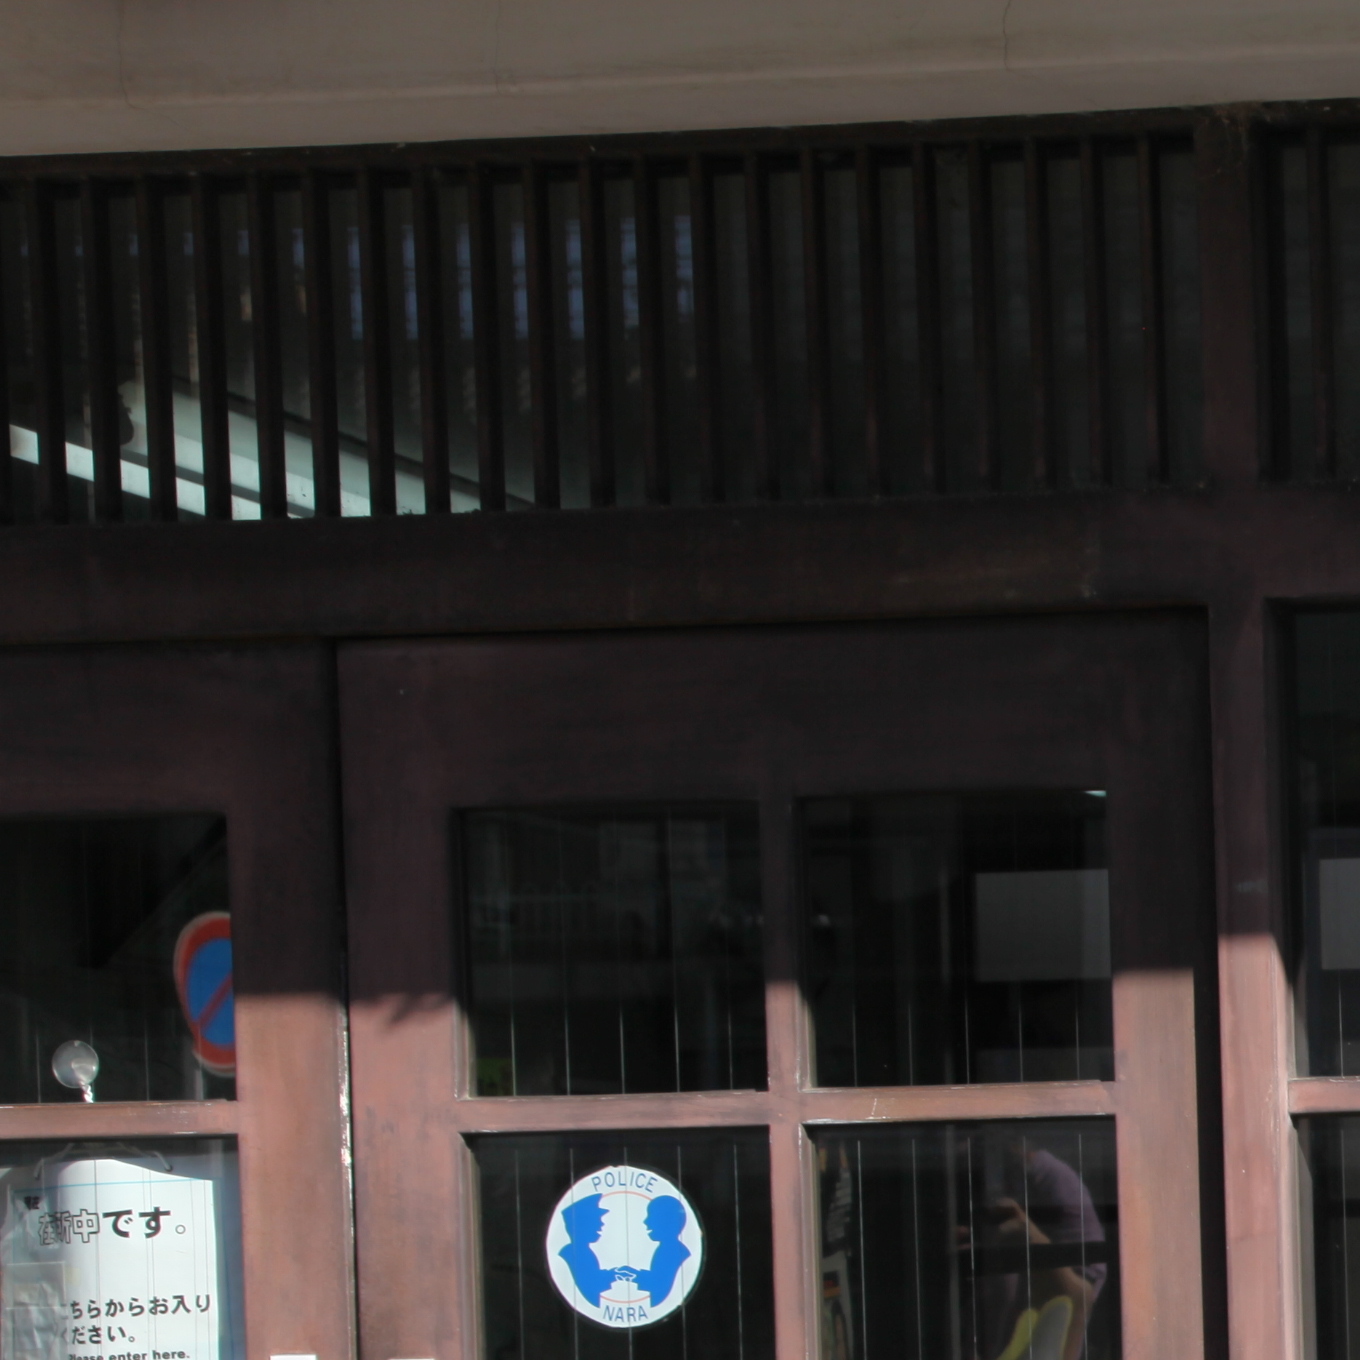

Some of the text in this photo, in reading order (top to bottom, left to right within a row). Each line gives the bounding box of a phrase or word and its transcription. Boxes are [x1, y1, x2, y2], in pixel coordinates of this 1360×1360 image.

[591, 1171, 659, 1193] POLICE
[602, 1304, 649, 1323] NARA
[152, 1349, 191, 1360] here.
